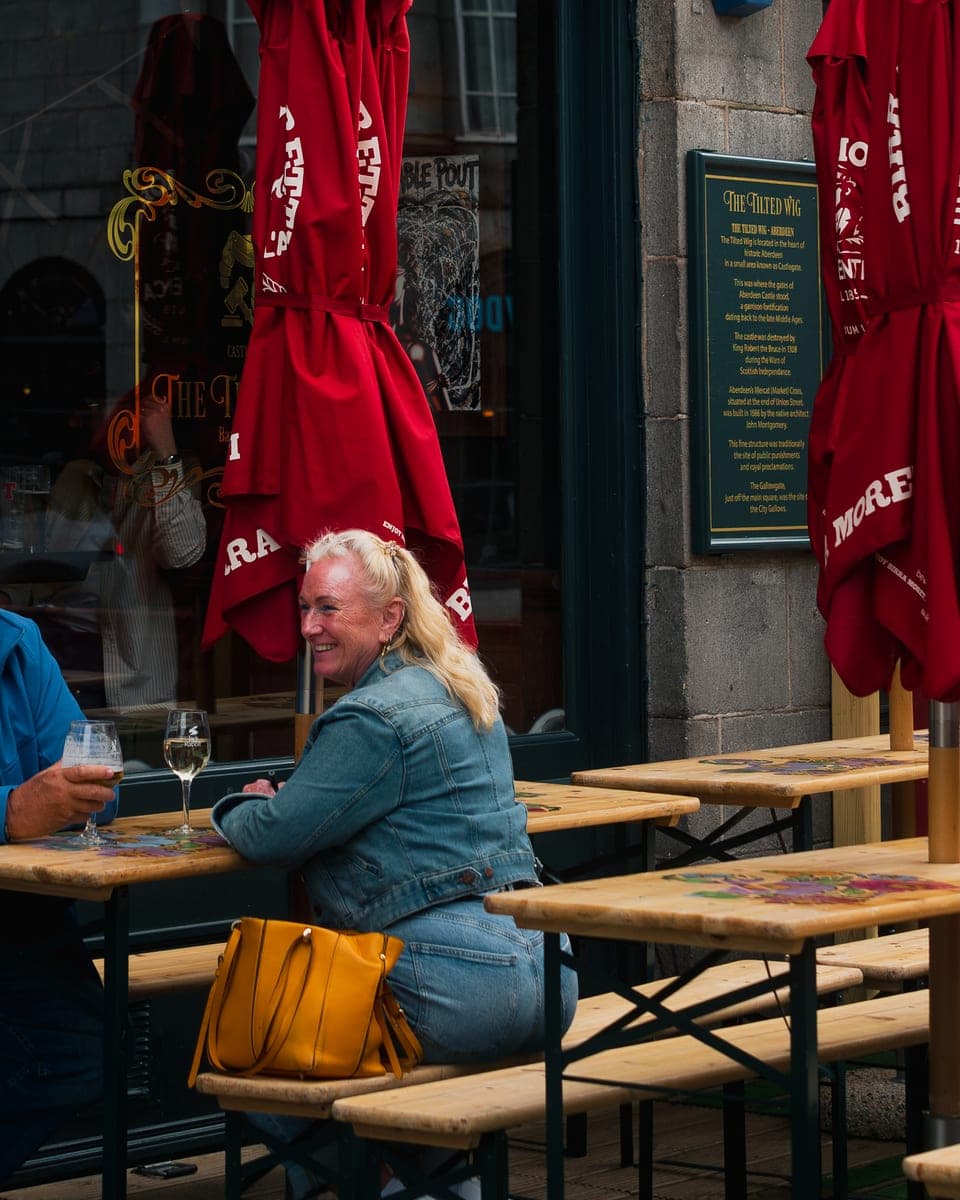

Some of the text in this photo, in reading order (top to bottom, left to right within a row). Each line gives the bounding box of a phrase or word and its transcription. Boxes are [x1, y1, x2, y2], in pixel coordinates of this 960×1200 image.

[401, 159, 433, 192] BLE
[723, 190, 801, 217] THE TILTED WIG
[720, 235, 730, 245] The
[744, 237, 753, 248] Wig
[757, 238, 774, 247] located
[733, 278, 744, 287] This
[768, 280, 776, 289] the
[788, 281, 794, 290] of
[152, 373, 207, 418] THE
